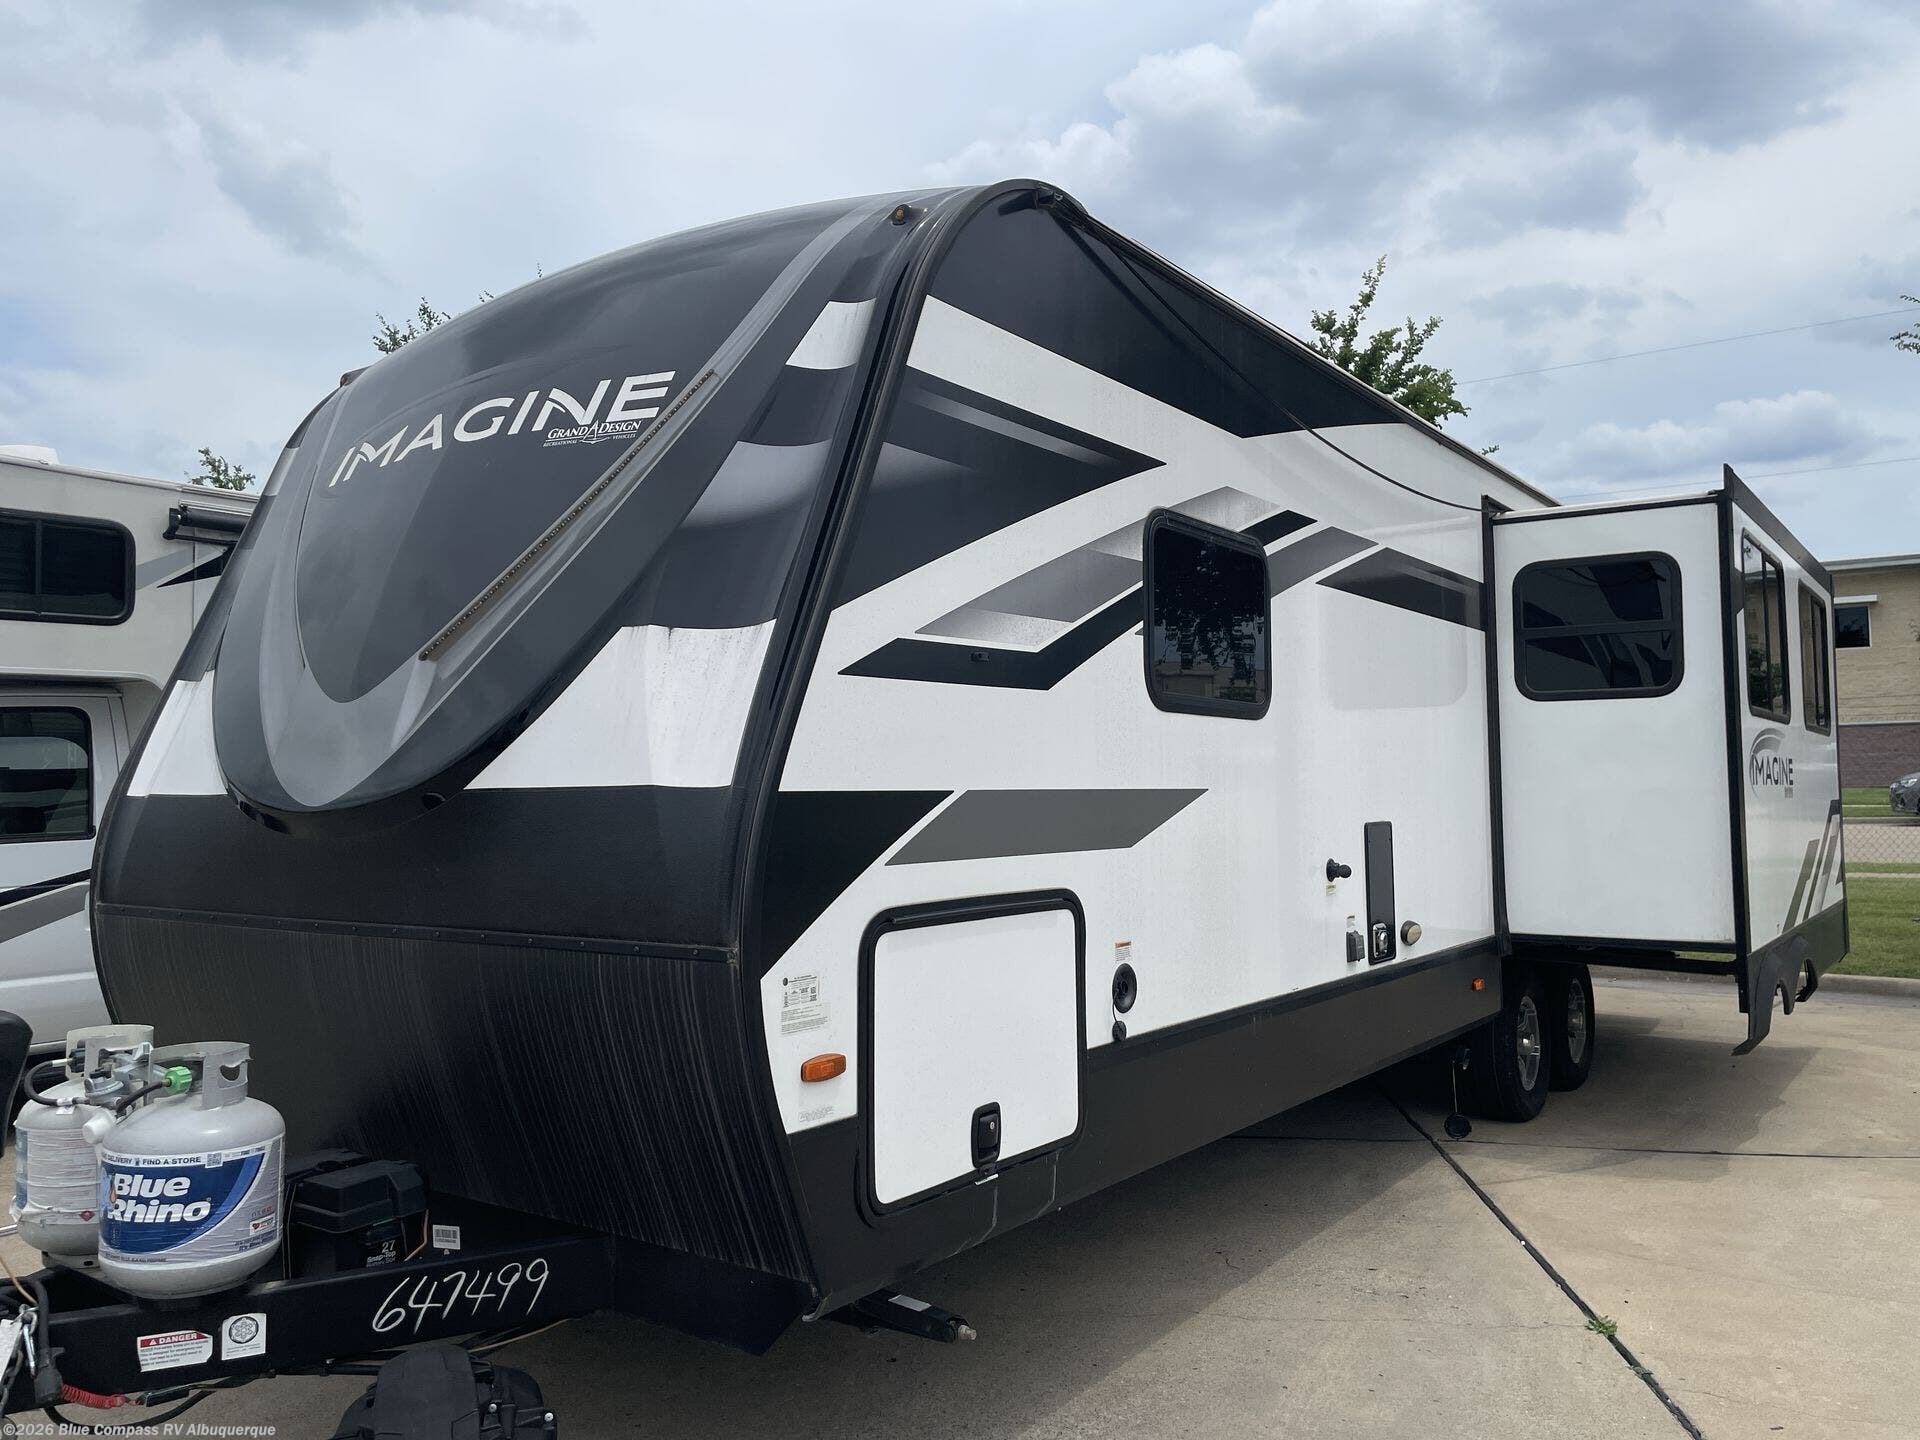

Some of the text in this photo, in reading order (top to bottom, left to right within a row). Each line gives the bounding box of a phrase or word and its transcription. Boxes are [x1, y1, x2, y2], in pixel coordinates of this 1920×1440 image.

[329, 371, 676, 488] IMAGINE
[547, 421, 641, 439] GRAND DESIGN
[1751, 755, 1794, 786] IMAGINE
[171, 1156, 201, 1165] STORE
[114, 1173, 191, 1198] Blue
[107, 1199, 211, 1223] Rhino
[381, 1240, 396, 1253] 27
[372, 1258, 549, 1335] 647499
[158, 1332, 198, 1345] DANGER
